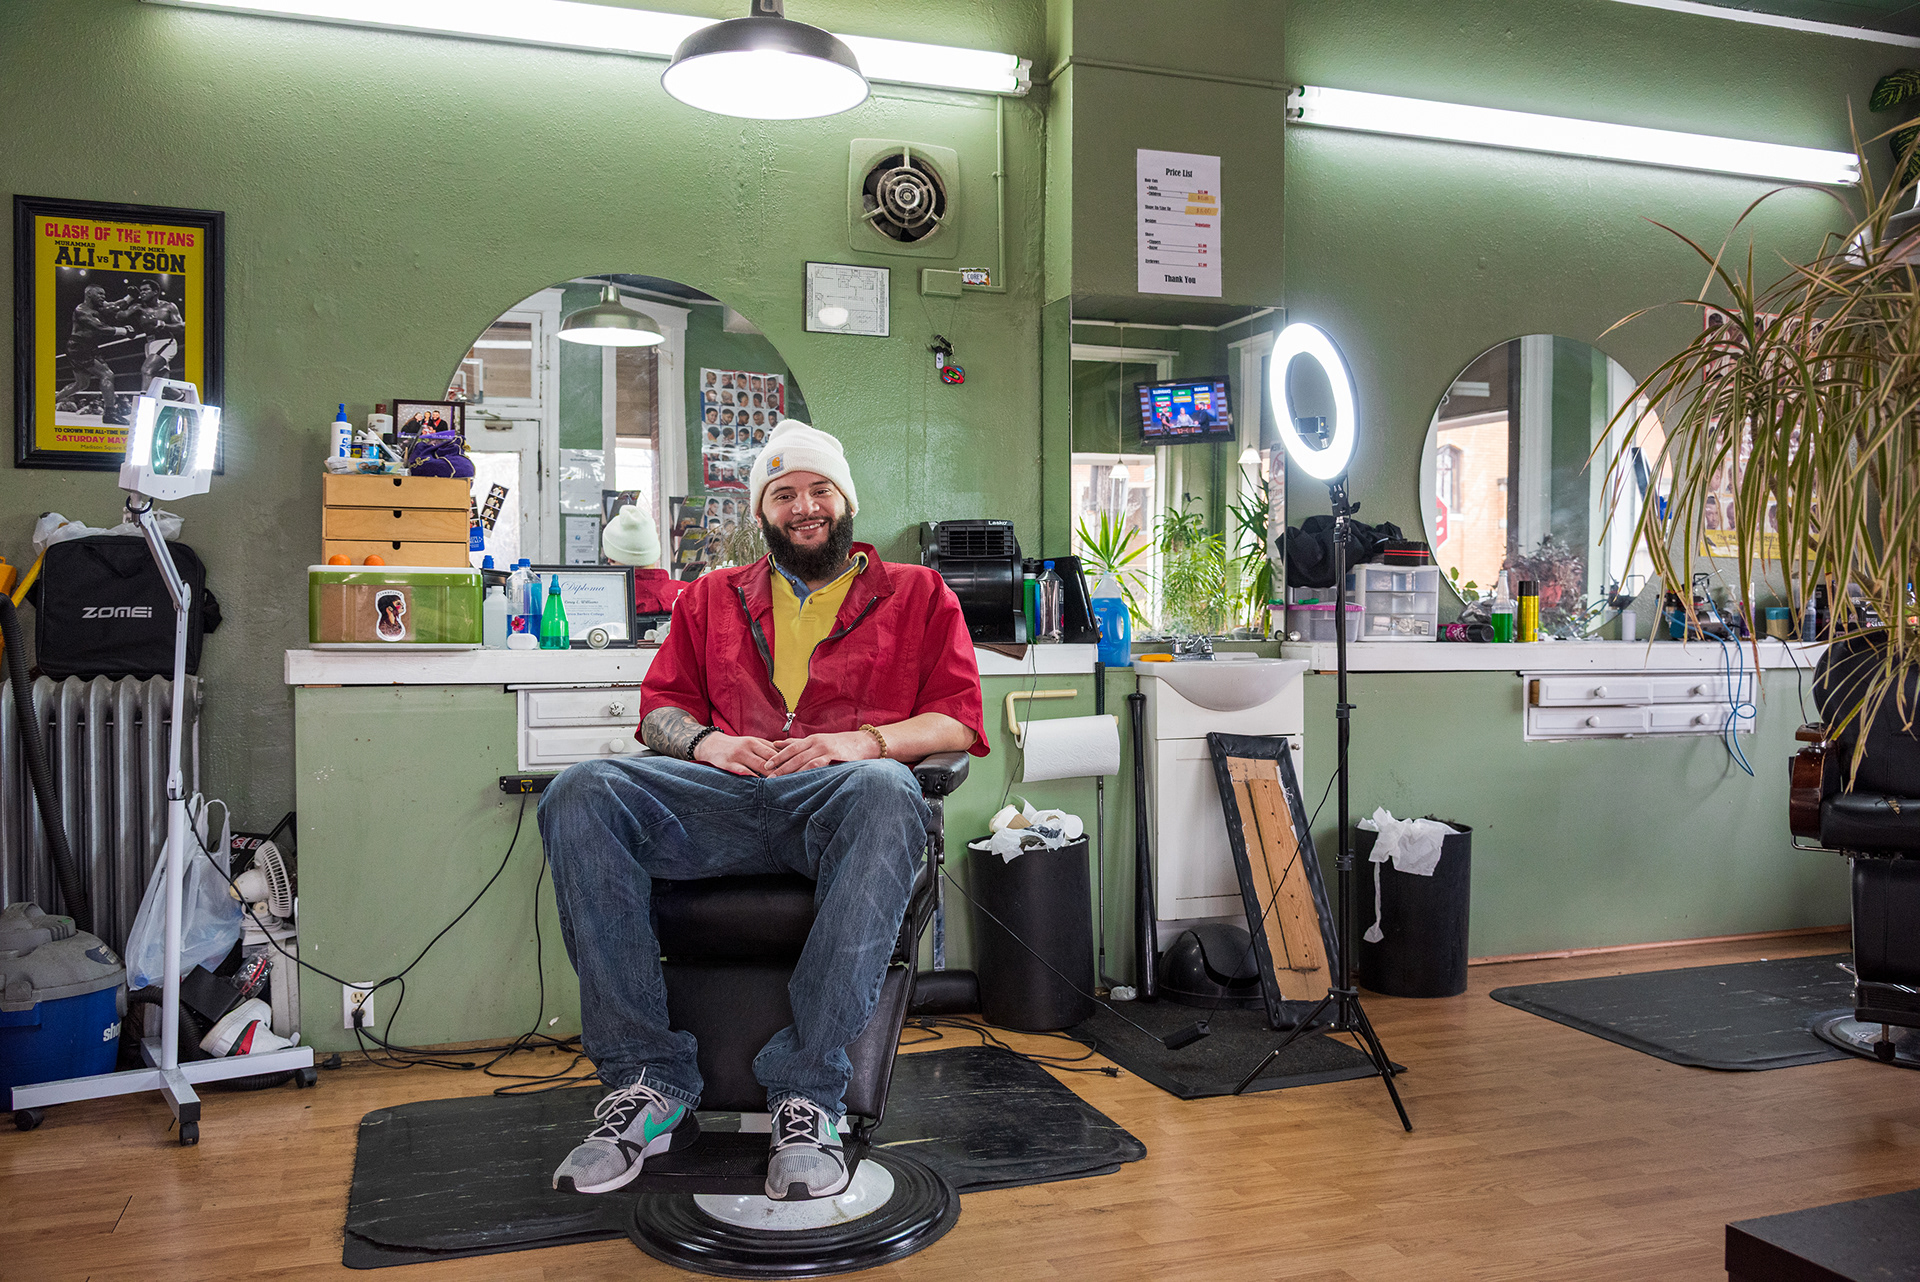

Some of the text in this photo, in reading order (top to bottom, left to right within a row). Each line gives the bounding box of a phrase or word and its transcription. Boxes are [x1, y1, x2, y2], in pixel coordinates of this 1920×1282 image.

[1165, 168, 1193, 178] Price List
[45, 222, 89, 240] CLASH
[94, 226, 111, 241] OF
[116, 228, 141, 244] THE
[146, 230, 195, 247] TITANS
[54, 240, 96, 248] MUHAMMAD
[54, 245, 95, 267] ALI
[108, 249, 186, 273] TYSON
[1164, 274, 1196, 284] Thank You
[56, 434, 105, 443] SATURDAY
[561, 581, 605, 595] Diploma
